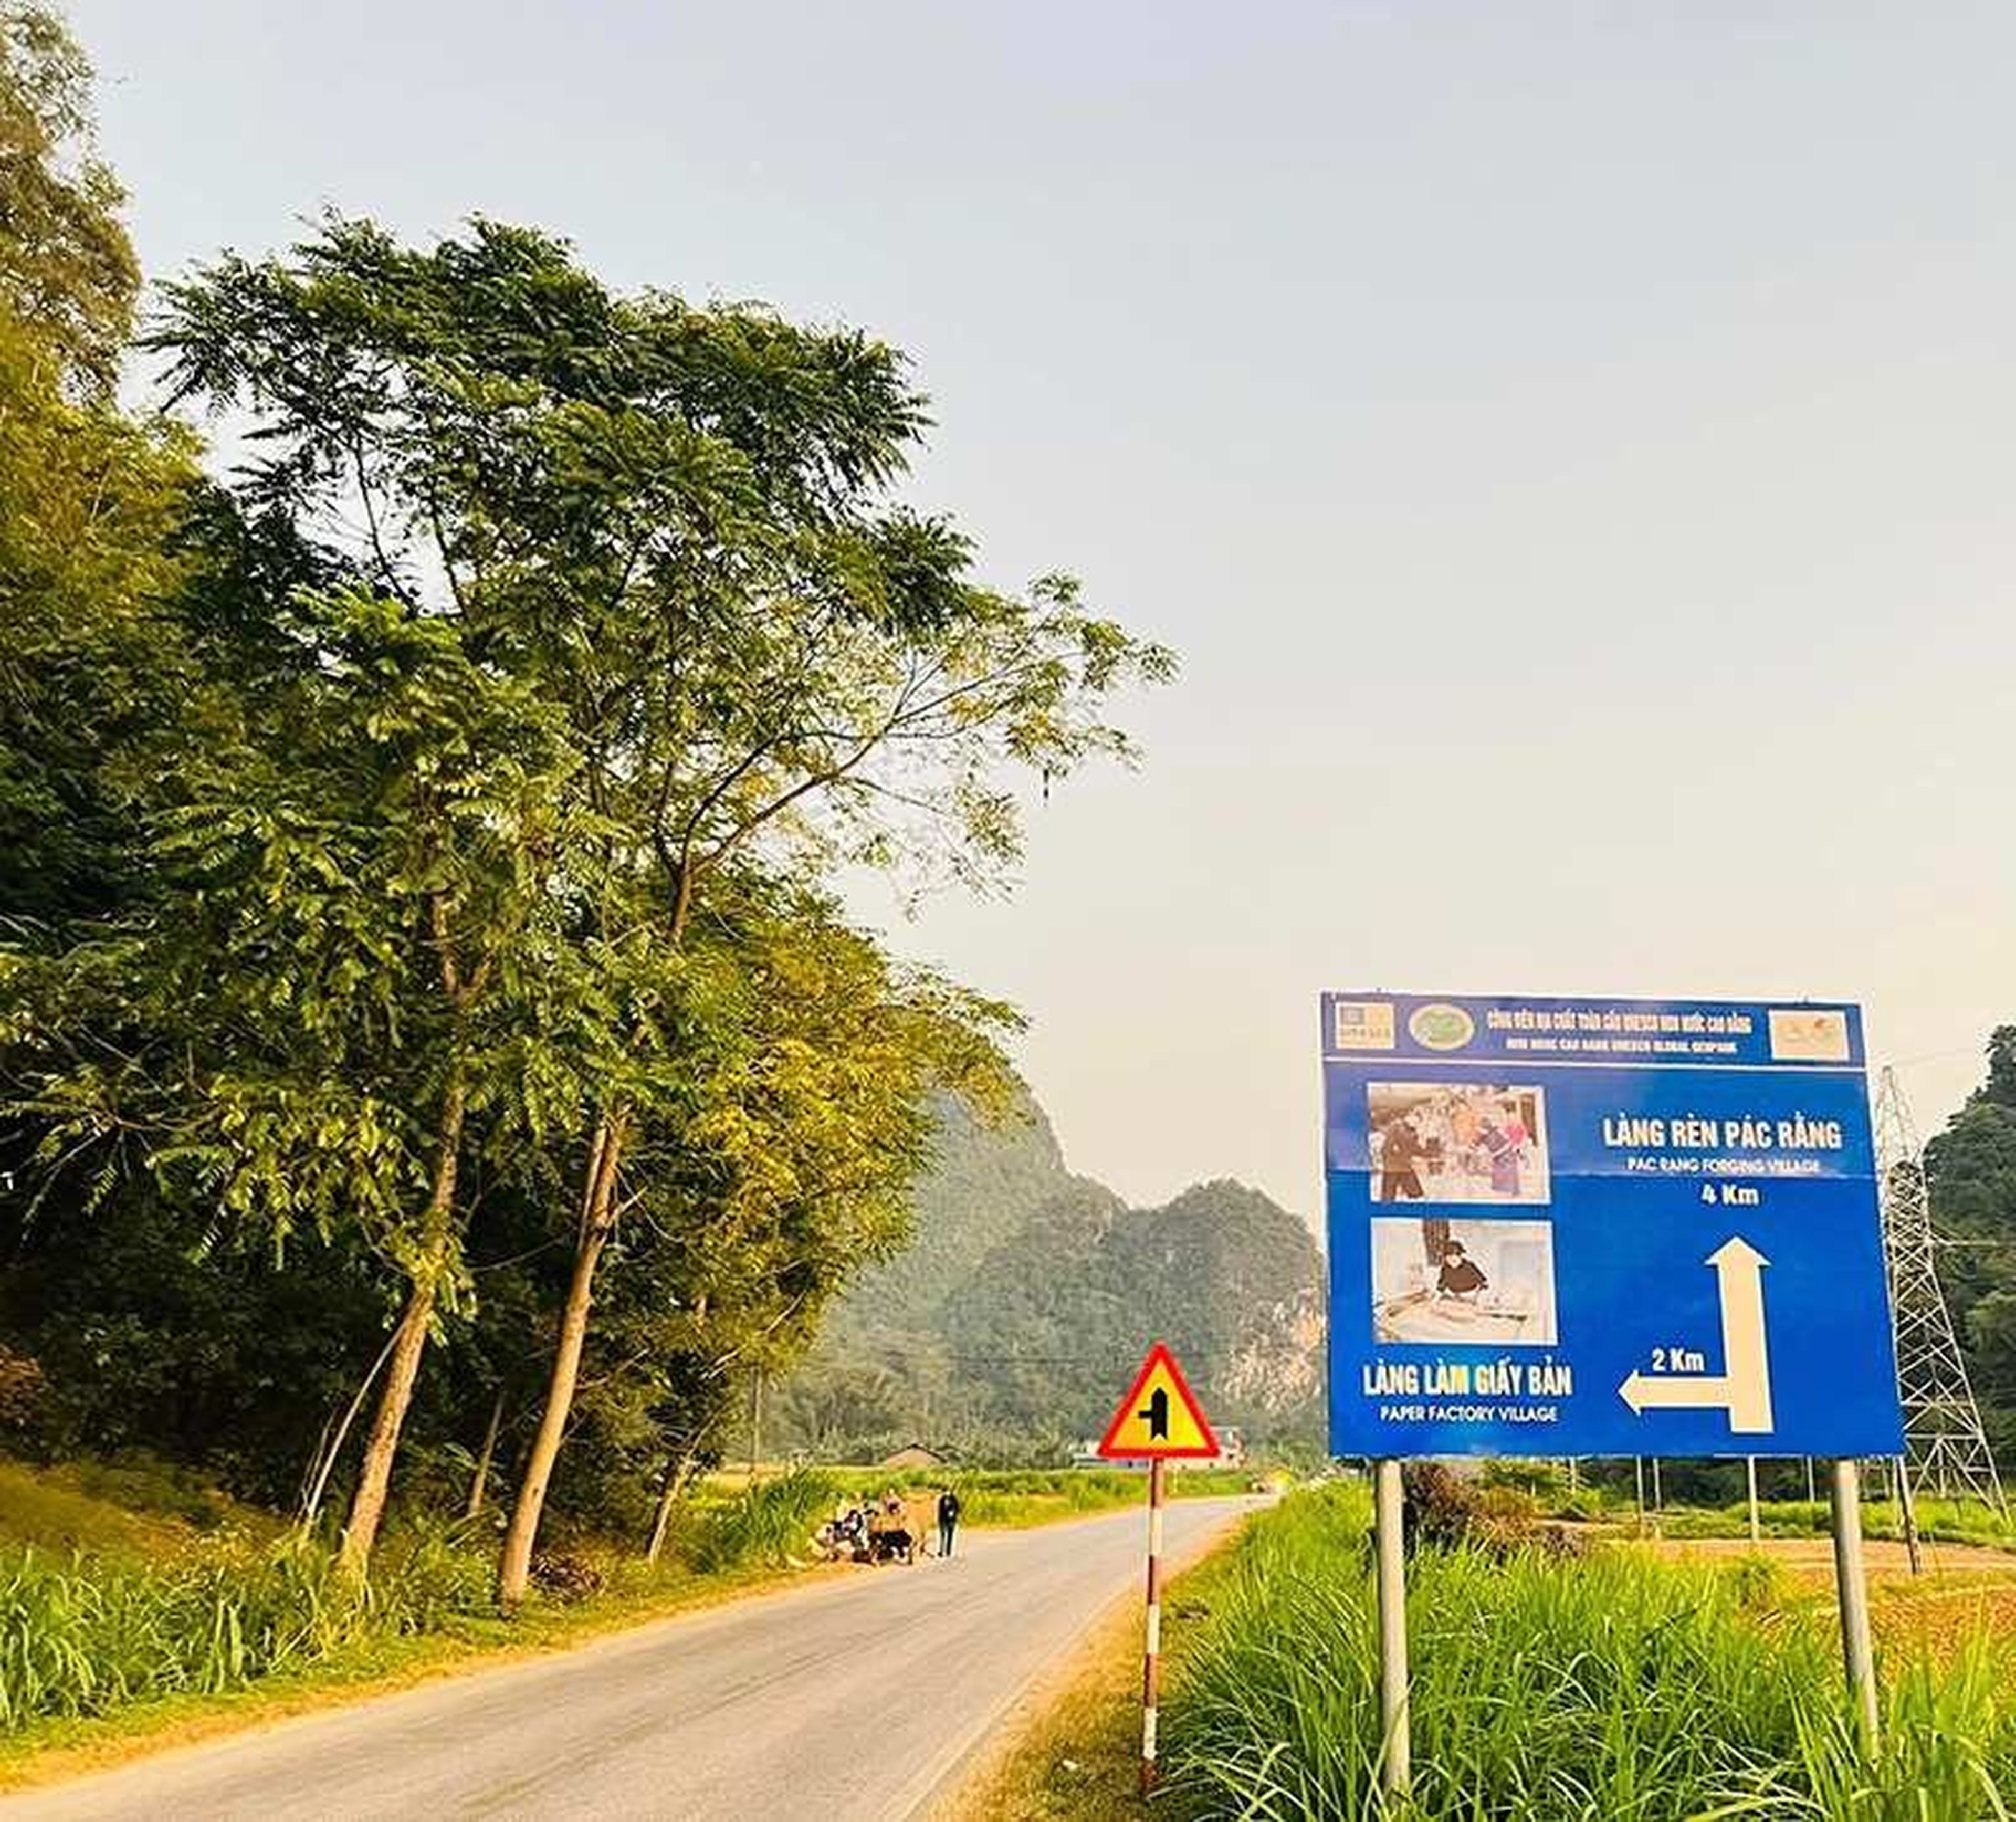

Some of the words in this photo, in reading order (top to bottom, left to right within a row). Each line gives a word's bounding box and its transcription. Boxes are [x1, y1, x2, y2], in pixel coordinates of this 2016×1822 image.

[1603, 1112, 1666, 1147] LÀNG
[1670, 1113, 1719, 1148] RÈN
[1724, 1114, 1773, 1149] PÁC
[1628, 1157, 1657, 1171] PAC
[1700, 1184, 1717, 1205] 4
[1721, 1184, 1759, 1205] Km
[1652, 1347, 1666, 1372] 2
[1669, 1347, 1705, 1372] Km
[1363, 1357, 1420, 1396] LÀNG
[1424, 1357, 1470, 1395] LÀM
[1474, 1355, 1522, 1396] GIẤY
[1380, 1405, 1425, 1421] PAPER
[1428, 1405, 1495, 1422] FACTORY
[1498, 1406, 1557, 1422] VILLAGE
